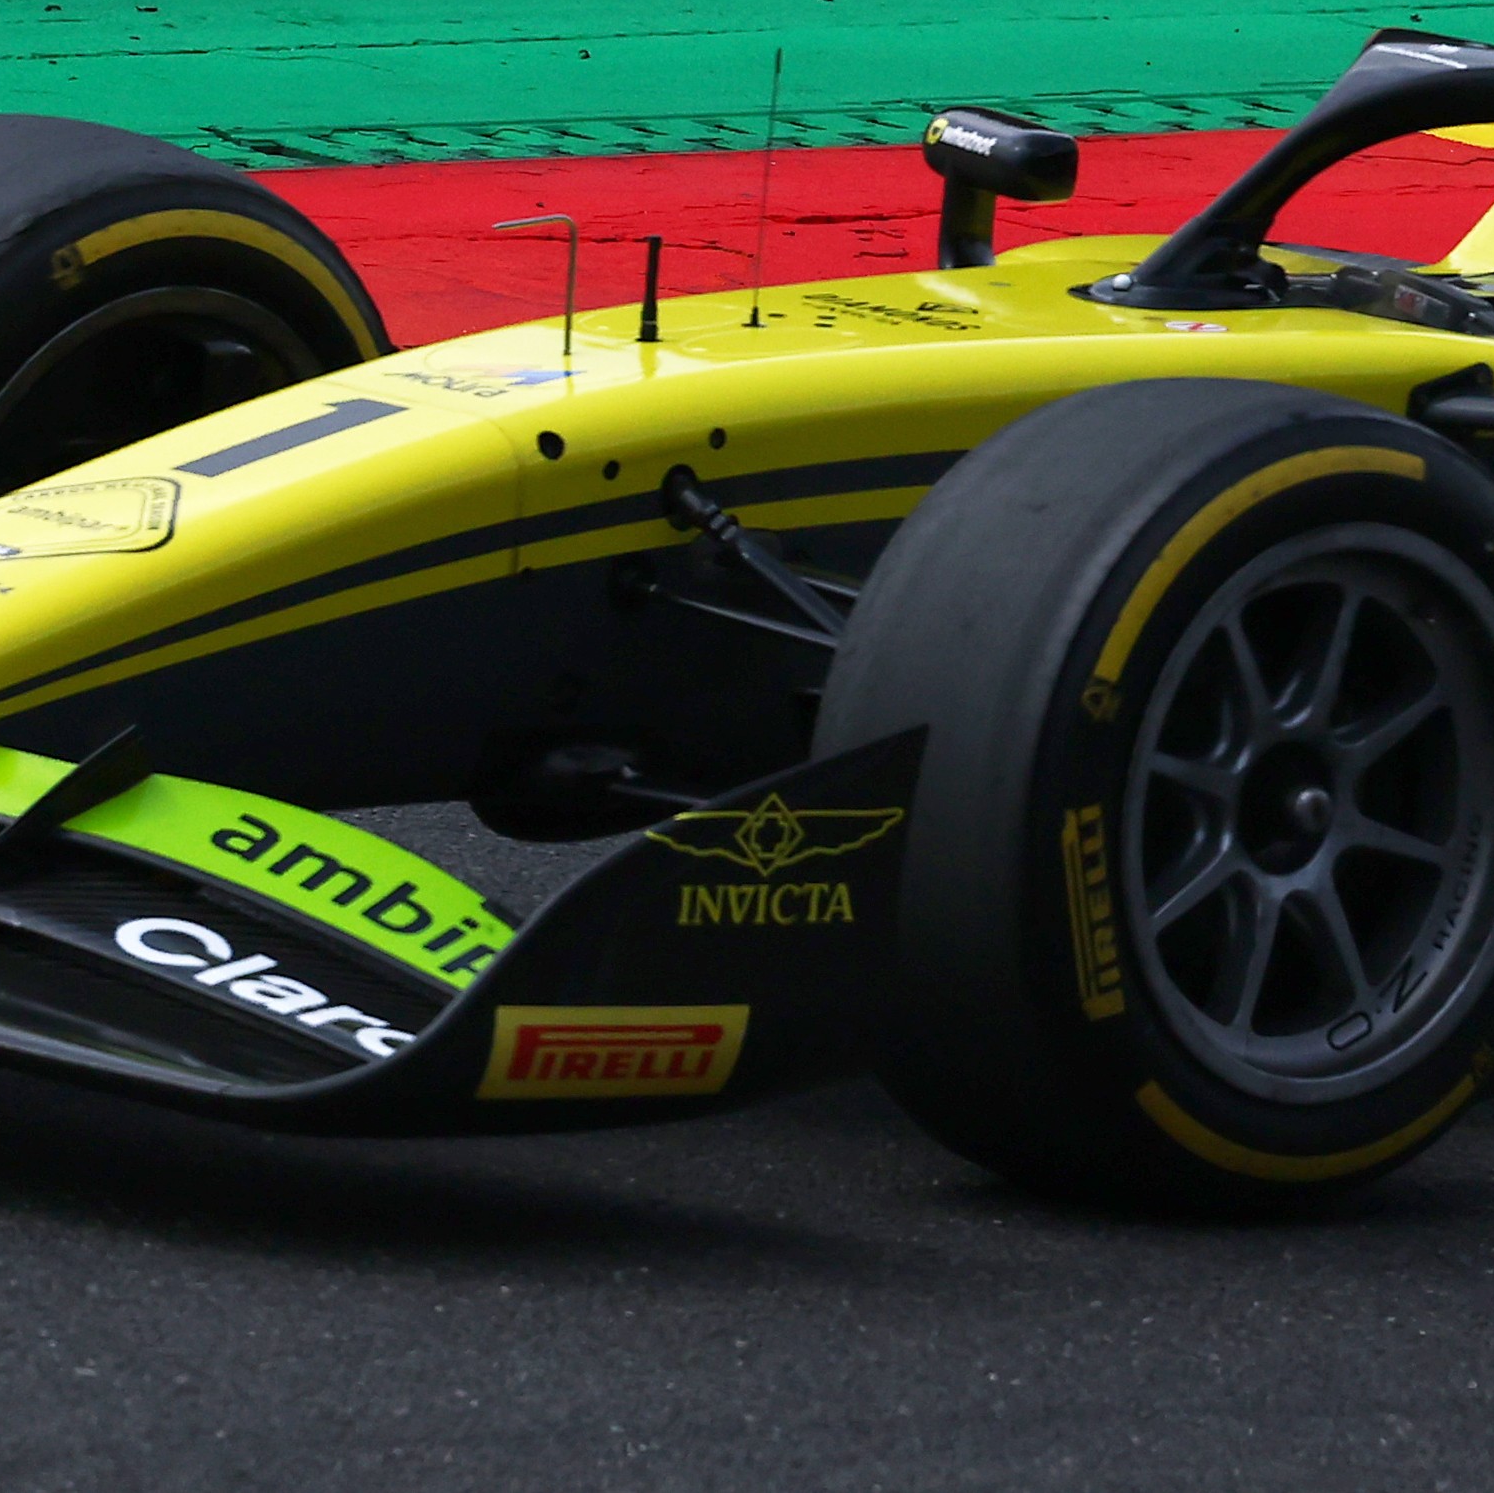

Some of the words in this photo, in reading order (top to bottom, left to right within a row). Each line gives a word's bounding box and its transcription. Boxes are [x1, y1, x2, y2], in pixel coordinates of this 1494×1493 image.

[173, 398, 410, 478] 1
[677, 883, 853, 926] INVICTA
[1062, 803, 1126, 1021] PIRELLI
[507, 1024, 725, 1081] PIRELLI
